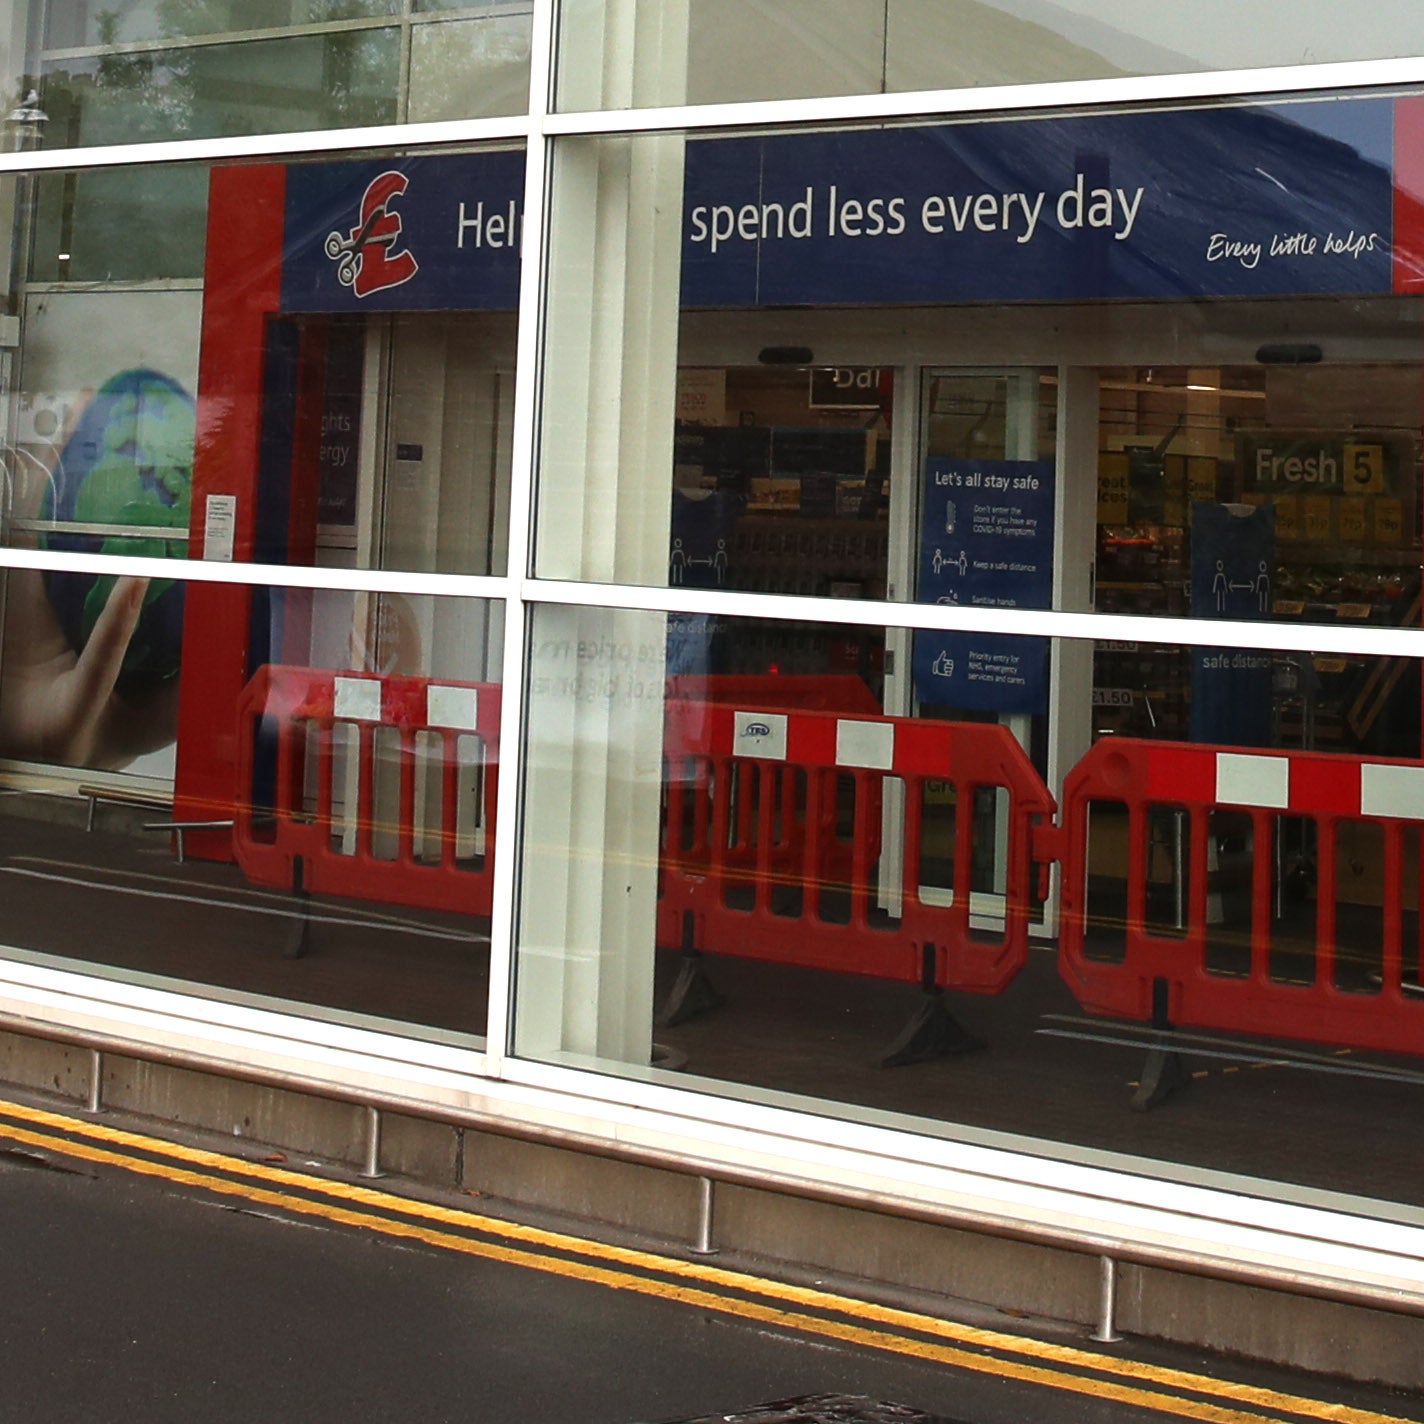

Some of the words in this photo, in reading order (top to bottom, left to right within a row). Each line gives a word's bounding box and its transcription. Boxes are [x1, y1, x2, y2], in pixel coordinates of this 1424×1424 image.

[457, 198, 524, 252] Hel
[691, 187, 813, 251] spend
[829, 185, 906, 237] less
[922, 187, 1045, 243] every
[1056, 174, 1144, 241] day
[1207, 234, 1261, 268] Every
[1270, 234, 1315, 260] little
[1323, 231, 1378, 259] helps
[321, 411, 351, 436] ghts
[320, 446, 350, 466] ergy
[1256, 448, 1336, 483] Fresh
[1353, 451, 1371, 484] 5
[935, 472, 962, 486] Let's
[965, 473, 981, 487] all
[984, 475, 1010, 492] stay
[1013, 475, 1039, 490] safe
[666, 621, 684, 633] afe
[688, 621, 728, 633] distanc
[1203, 655, 1229, 669] safe
[1231, 654, 1271, 669] distanc
[927, 780, 956, 793] Gre
